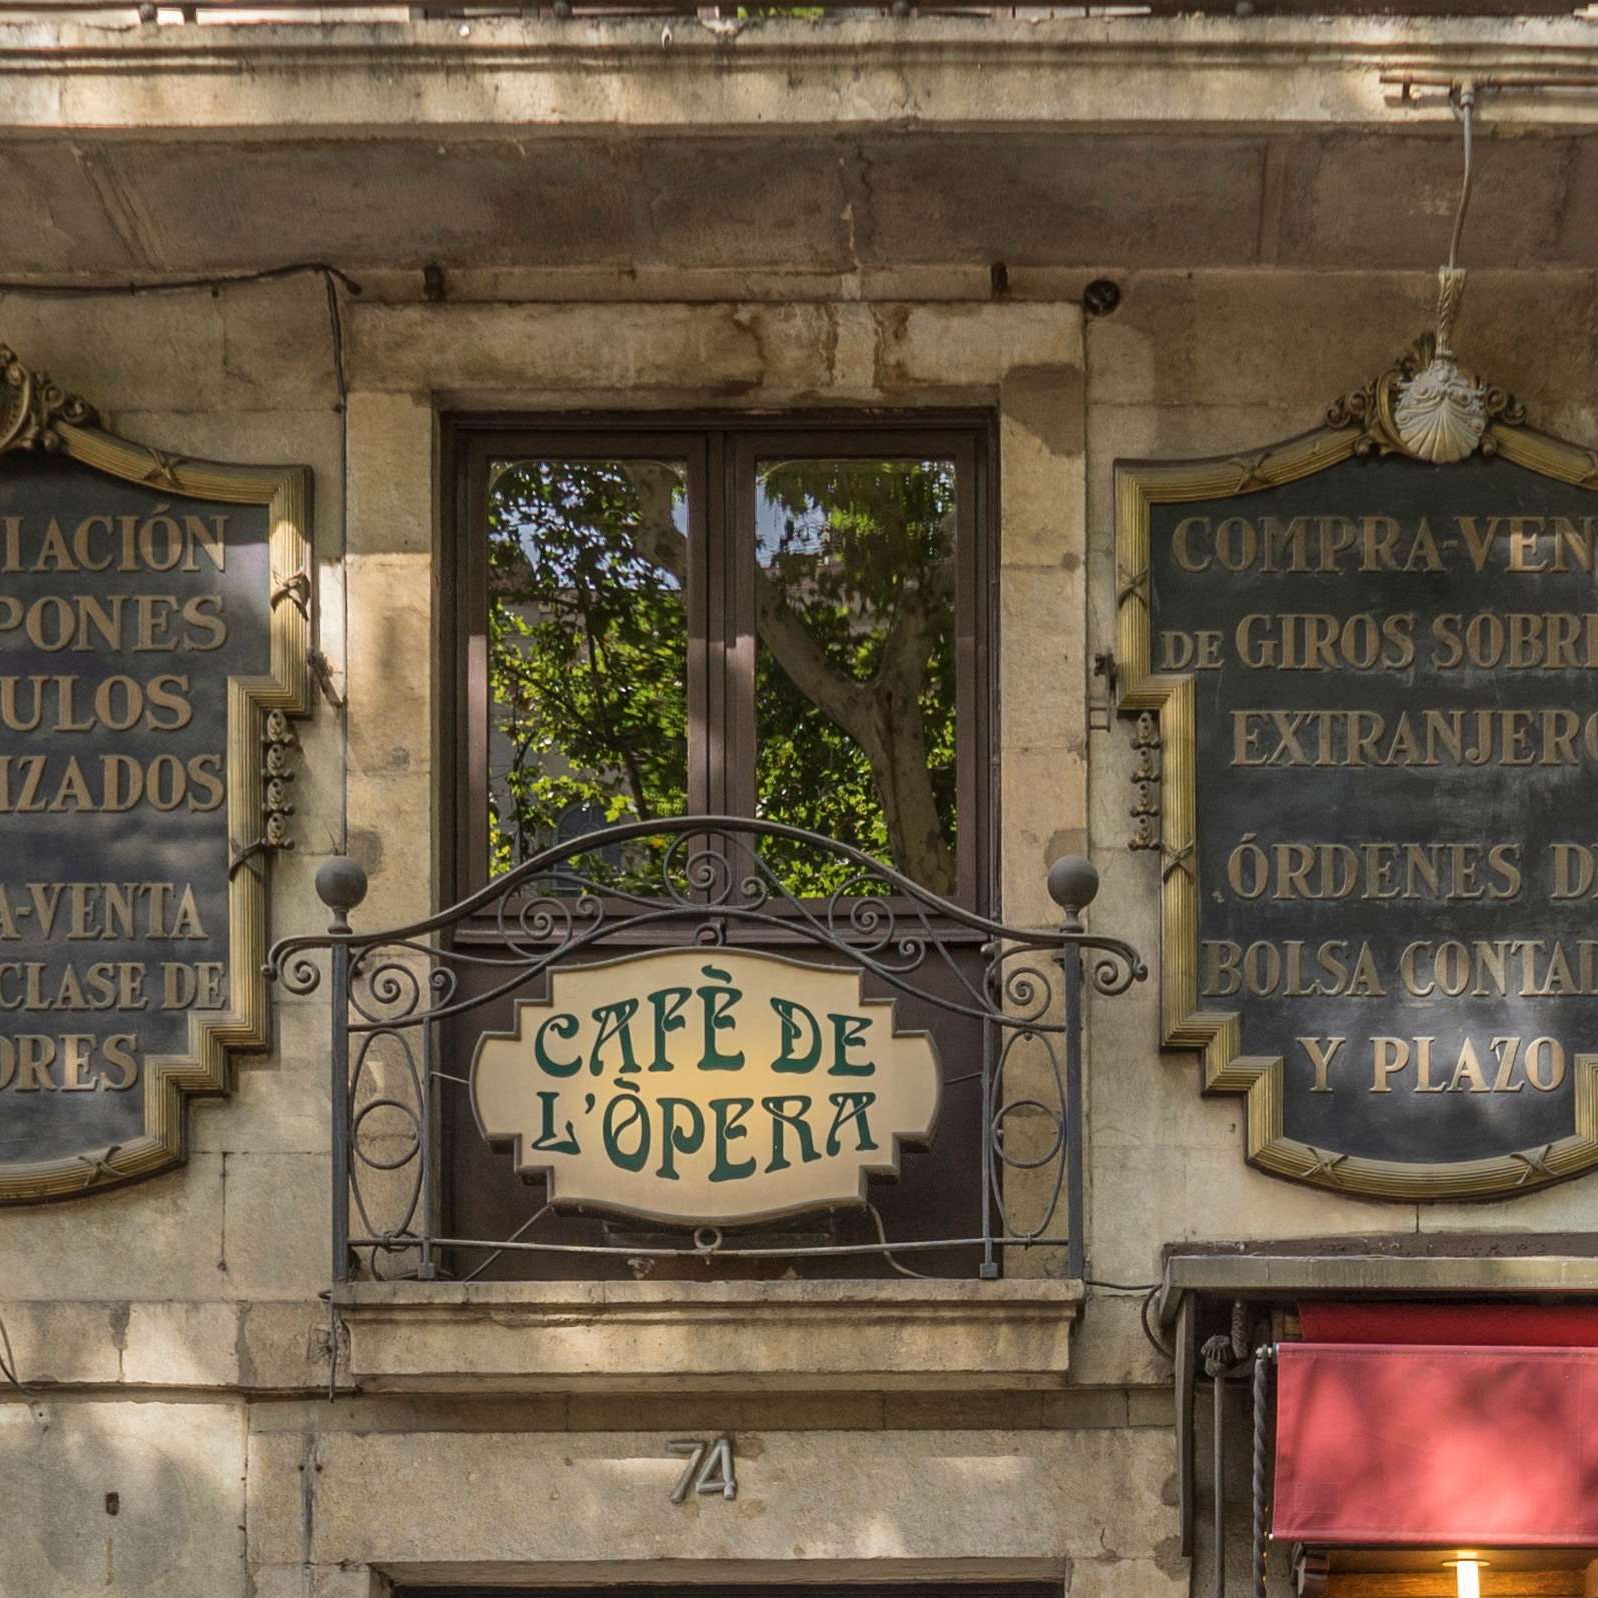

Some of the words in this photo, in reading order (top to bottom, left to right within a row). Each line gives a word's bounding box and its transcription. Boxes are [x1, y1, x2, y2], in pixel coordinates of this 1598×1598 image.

[1162, 630, 1224, 671] DE
[1235, 612, 1417, 671] GIROS
[1228, 832, 1523, 902] ÓRDENES
[163, 960, 228, 1011] DE
[1203, 939, 1384, 998] BOLSA
[533, 964, 746, 1078] CAFÈ
[770, 996, 876, 1077] DE
[1297, 1037, 1346, 1094] Y
[1369, 1037, 1567, 1095] PLAZO
[666, 1438, 737, 1504] 74
